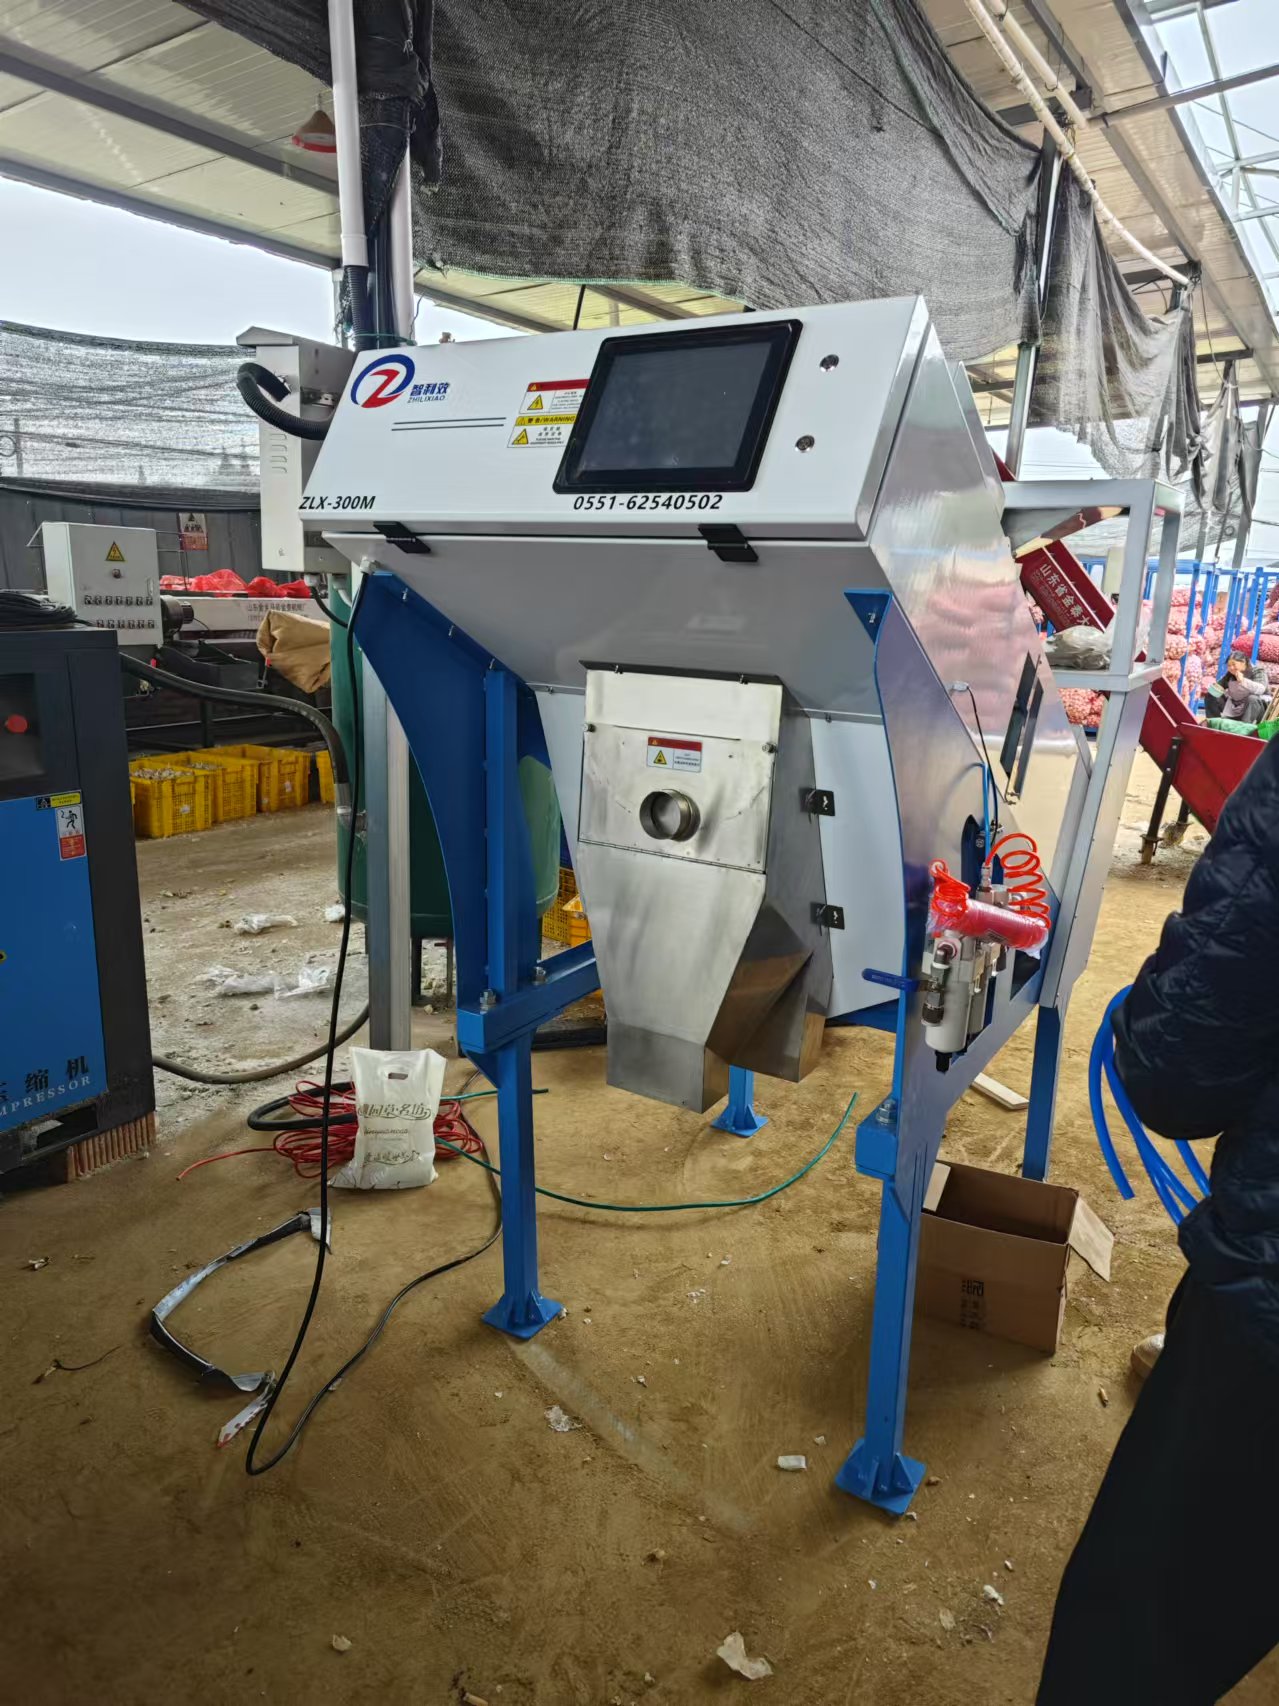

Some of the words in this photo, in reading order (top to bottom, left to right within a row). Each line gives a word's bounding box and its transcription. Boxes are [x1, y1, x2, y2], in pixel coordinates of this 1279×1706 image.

[410, 382, 450, 397] 智利效
[407, 394, 446, 404] ZHILIXIAO
[299, 495, 376, 510] ZLX-300M
[573, 494, 723, 511] 0551-62540502
[0, 1055, 90, 1102] 缩机
